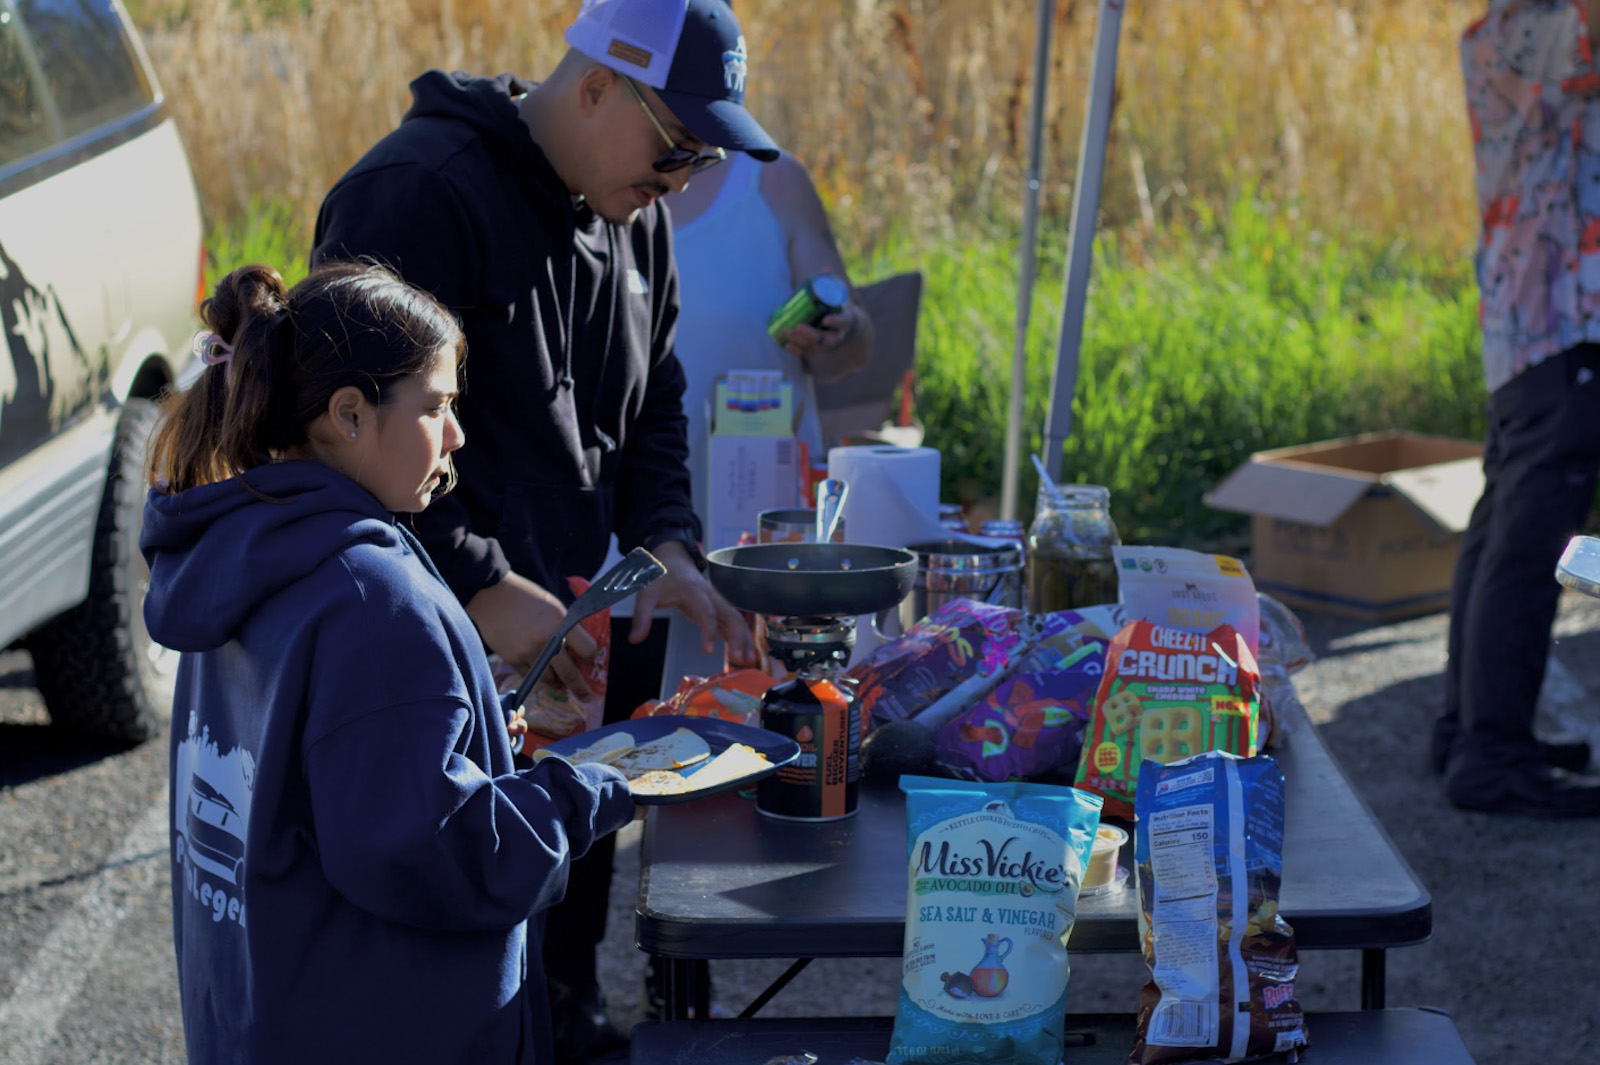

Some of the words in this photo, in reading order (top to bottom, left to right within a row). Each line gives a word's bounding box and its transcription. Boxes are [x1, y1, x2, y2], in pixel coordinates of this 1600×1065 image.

[1168, 606, 1225, 630] ORGANIC
[1118, 649, 1239, 686] CRUNCH
[1146, 685, 1176, 694] SHARP
[1177, 686, 1206, 694] WHITE
[801, 744, 817, 753] OIL
[838, 710, 846, 783] ADVENTURES
[825, 754, 833, 785] FUEL
[948, 817, 975, 831] KETTLE
[975, 814, 1003, 824] COOKED
[1153, 811, 1185, 822] Nutrition
[1187, 808, 1209, 817] Facts
[1153, 839, 1180, 847] Calories
[1191, 832, 1209, 841] 150
[914, 840, 984, 878] Miss
[930, 880, 991, 893] AVOCADO
[995, 881, 1020, 894] OIL
[920, 905, 943, 922] SEA
[946, 906, 977, 922] SALT
[981, 907, 994, 923] &
[997, 907, 1056, 930] VINEGAR
[1263, 984, 1294, 1007] RUFF
